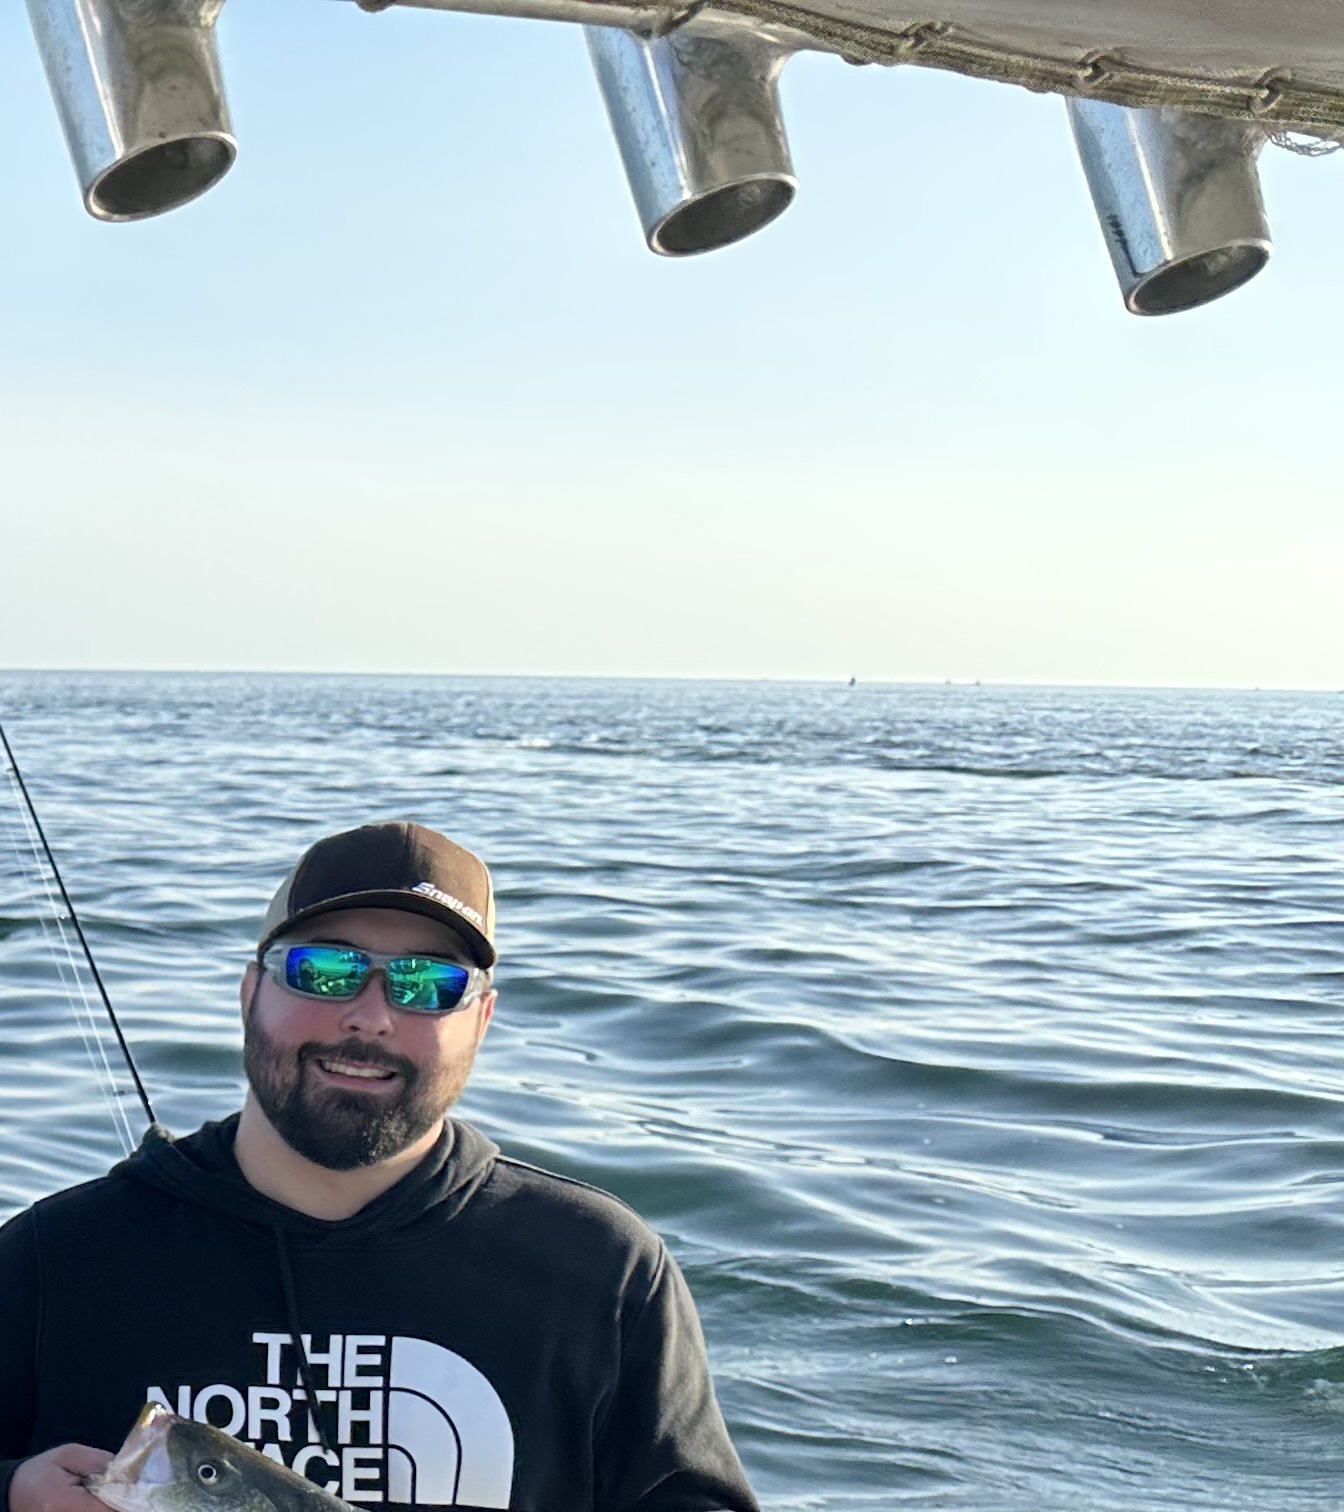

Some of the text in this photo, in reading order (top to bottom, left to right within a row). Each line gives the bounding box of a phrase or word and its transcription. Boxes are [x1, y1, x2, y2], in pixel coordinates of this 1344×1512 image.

[252, 1331, 386, 1388] THE
[146, 1383, 385, 1445] NORTH
[244, 1442, 384, 1502] CE
